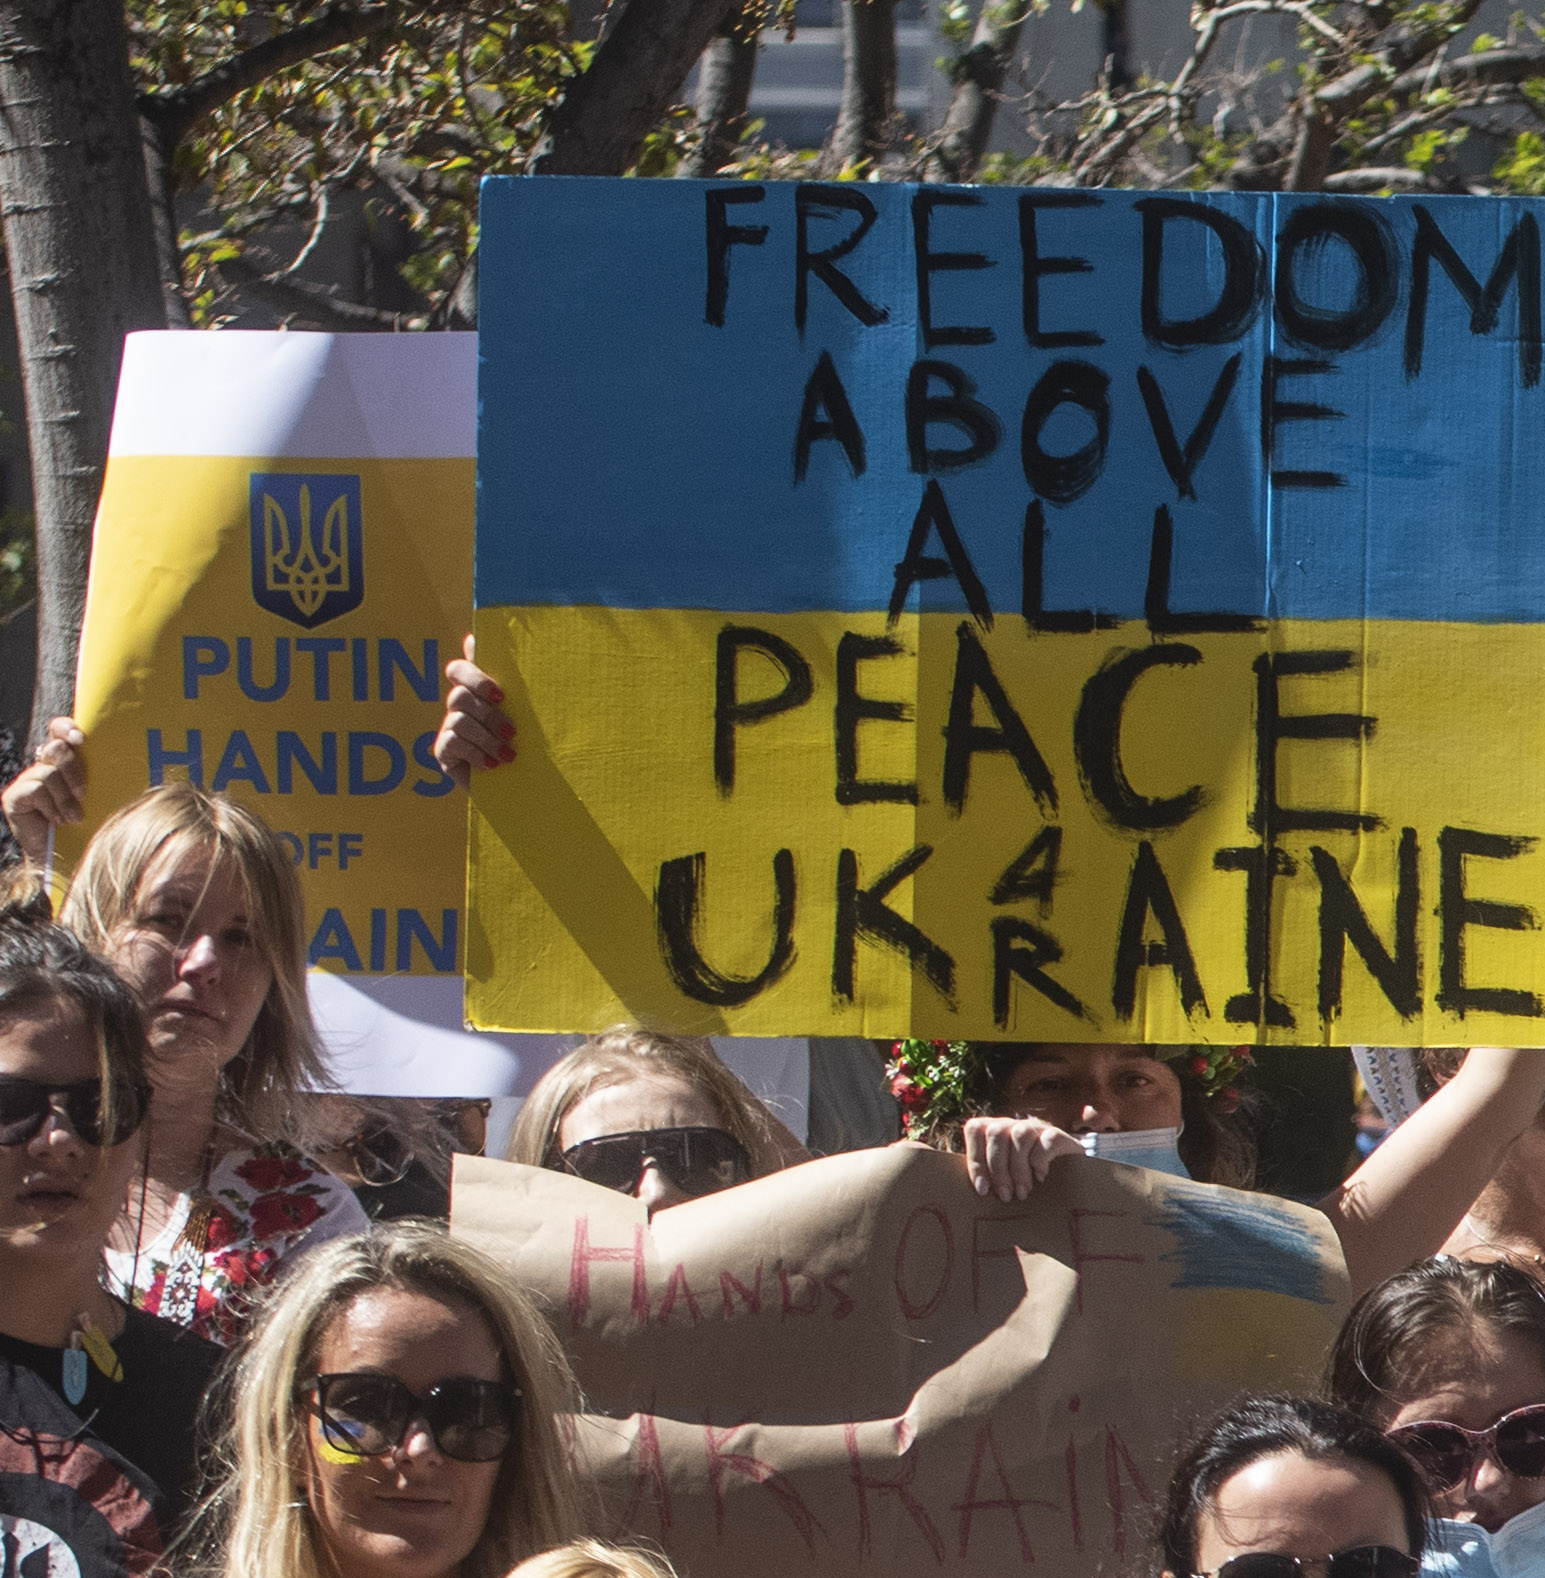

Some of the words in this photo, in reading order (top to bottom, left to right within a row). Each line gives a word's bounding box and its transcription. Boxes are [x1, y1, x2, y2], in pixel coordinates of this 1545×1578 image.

[702, 183, 1543, 389] FREEDOM
[793, 350, 1346, 504] ABOVE
[887, 480, 1268, 633] ALL
[183, 636, 440, 702] PUTIN
[712, 622, 1387, 834] PEACE
[146, 728, 456, 797] HANDS
